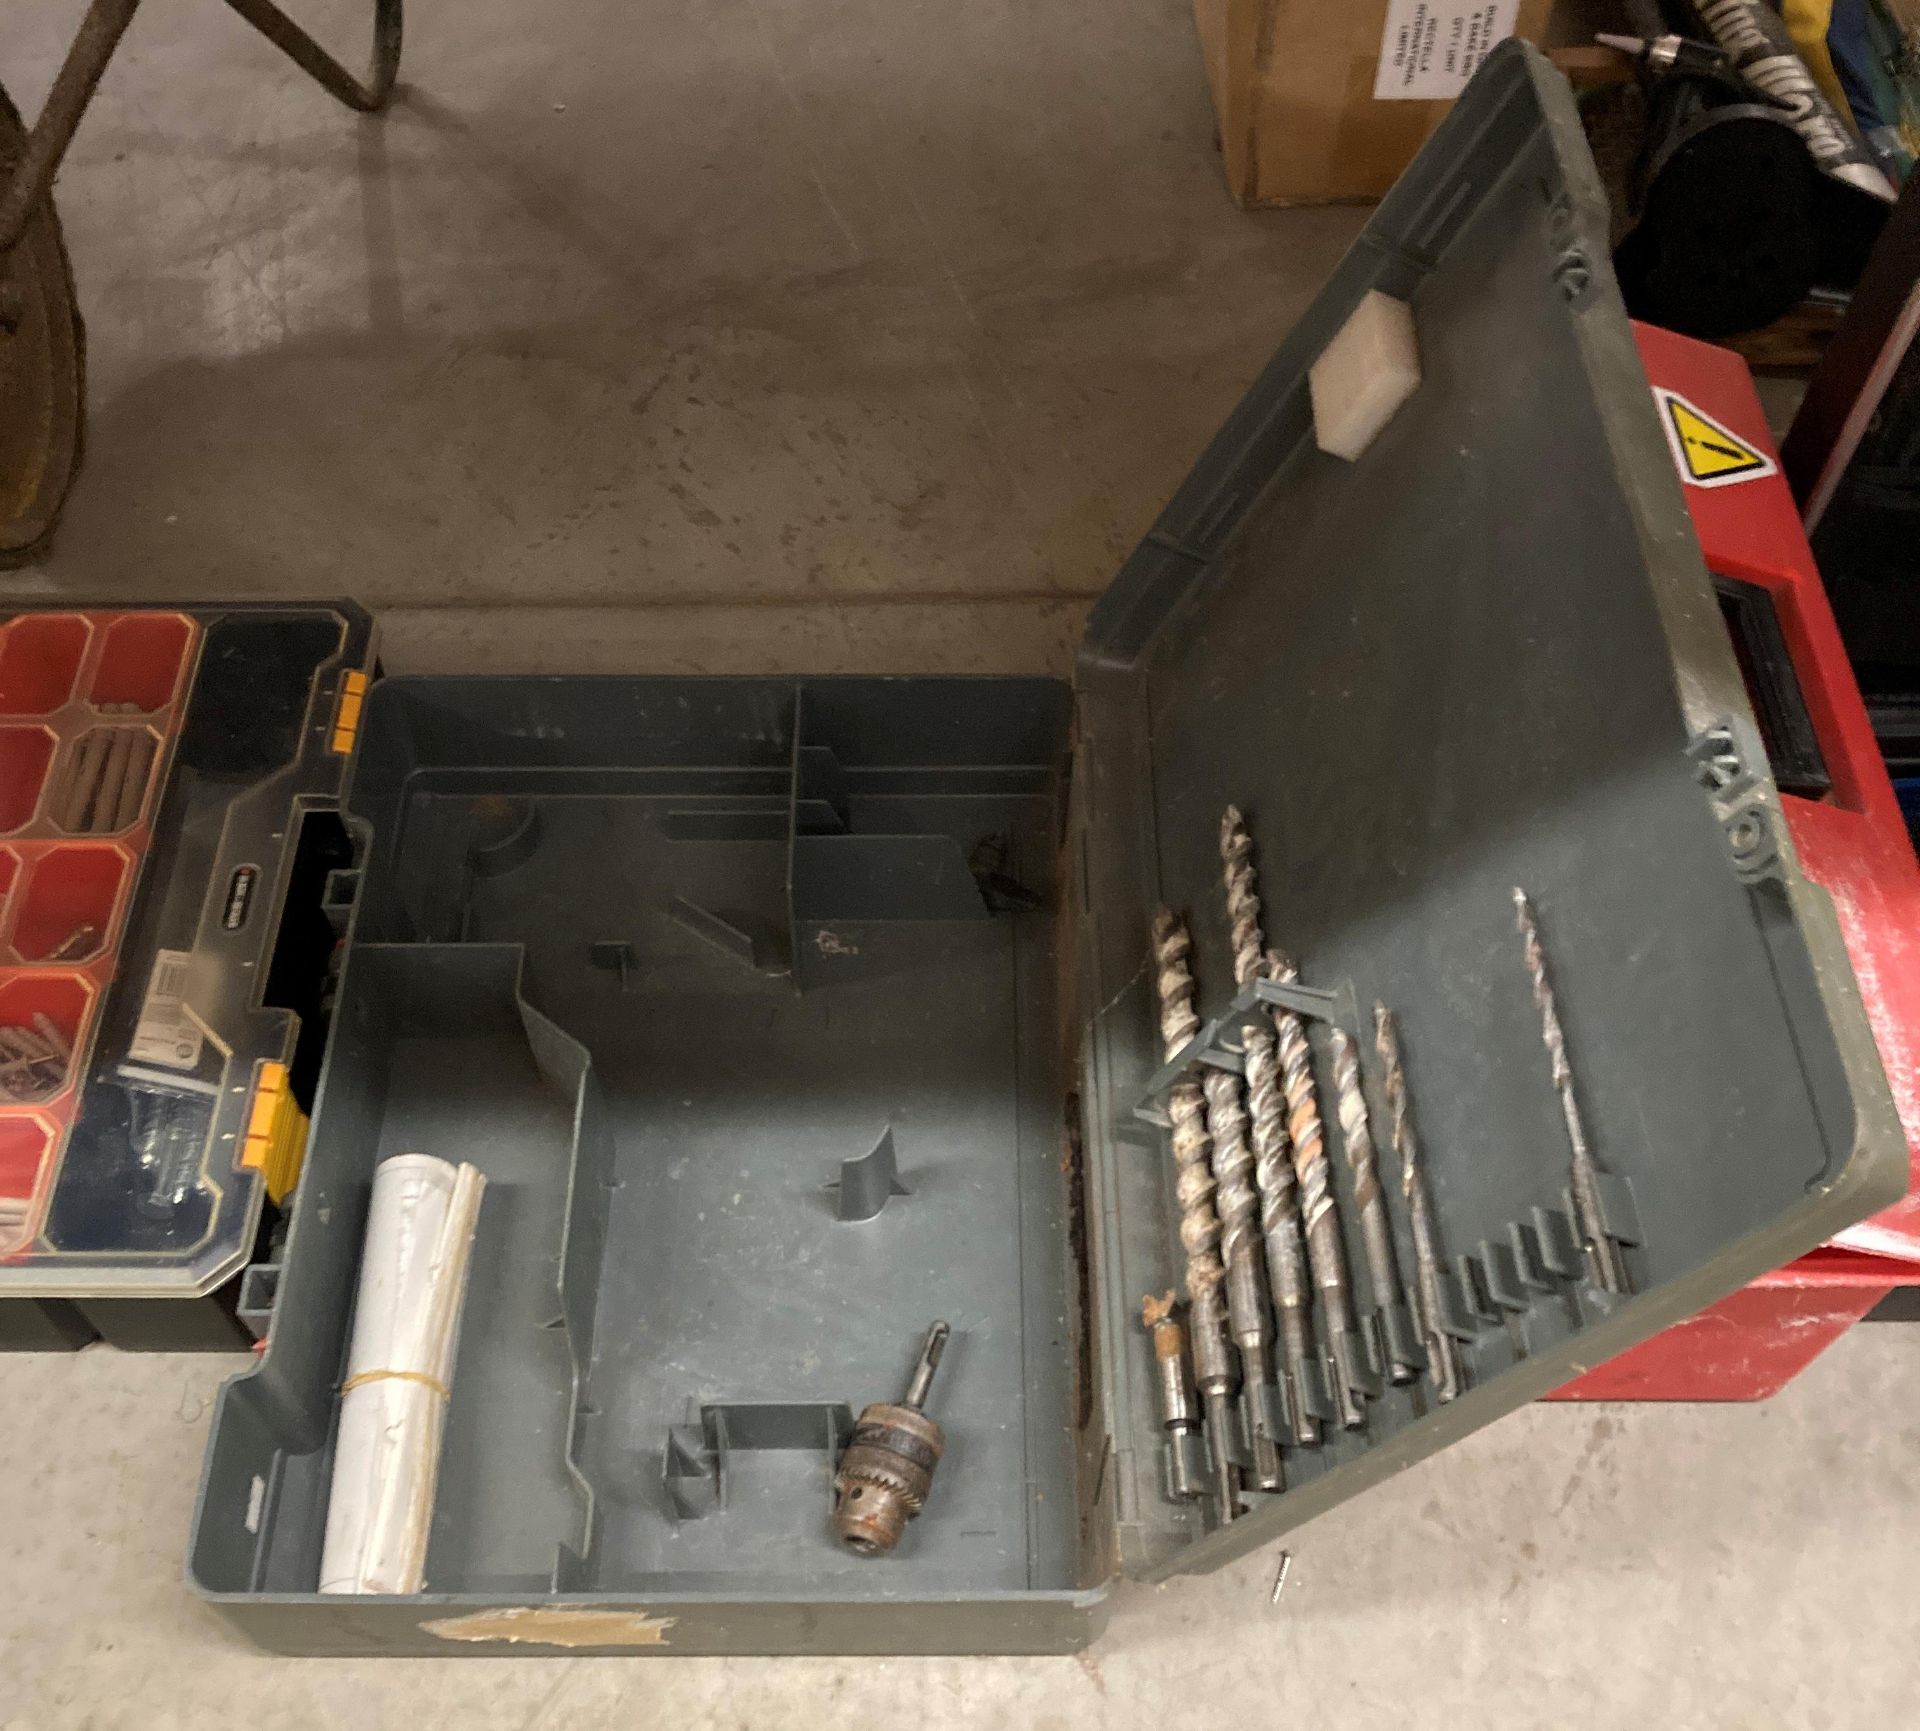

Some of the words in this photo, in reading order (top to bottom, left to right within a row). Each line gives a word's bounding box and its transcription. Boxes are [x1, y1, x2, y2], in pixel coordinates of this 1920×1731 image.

[1451, 17, 1465, 39] QTY
[1393, 25, 1410, 67] LIMITED
[1402, 4, 1428, 86] INTERNATIONAL
[1445, 50, 1456, 73] UNIT
